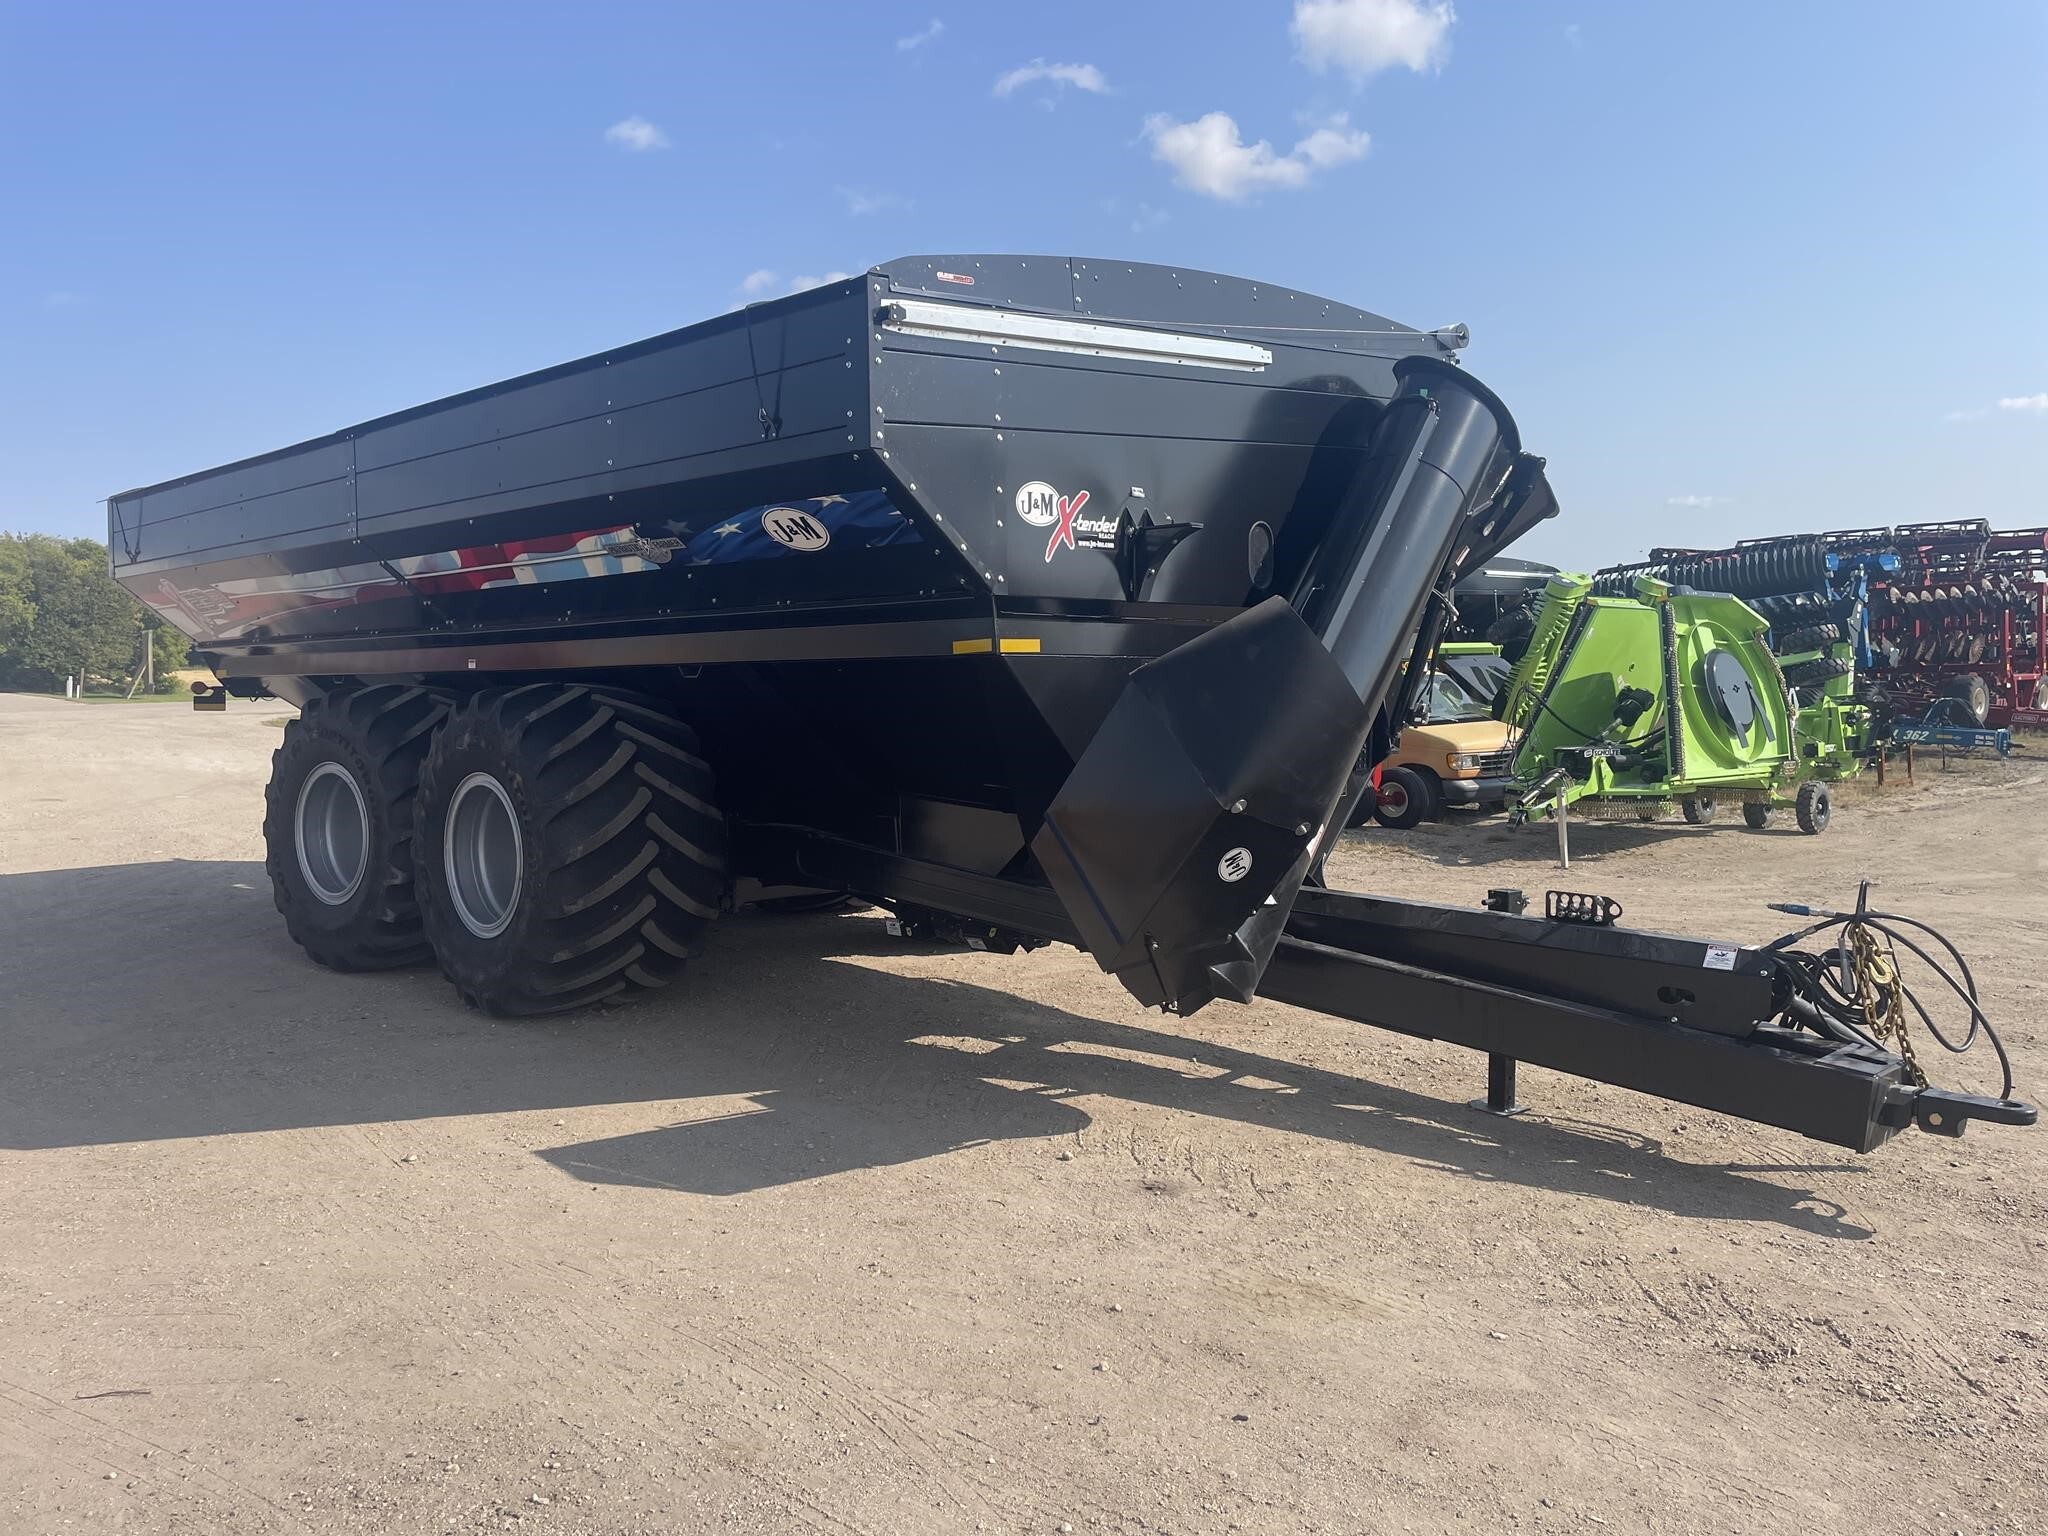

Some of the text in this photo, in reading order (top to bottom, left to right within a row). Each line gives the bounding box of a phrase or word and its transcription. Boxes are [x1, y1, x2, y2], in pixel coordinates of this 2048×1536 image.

[1021, 491, 1055, 517] J&M
[772, 516, 823, 543] J&M
[1903, 729, 1930, 740] 362
[1225, 851, 1247, 877] J&M
